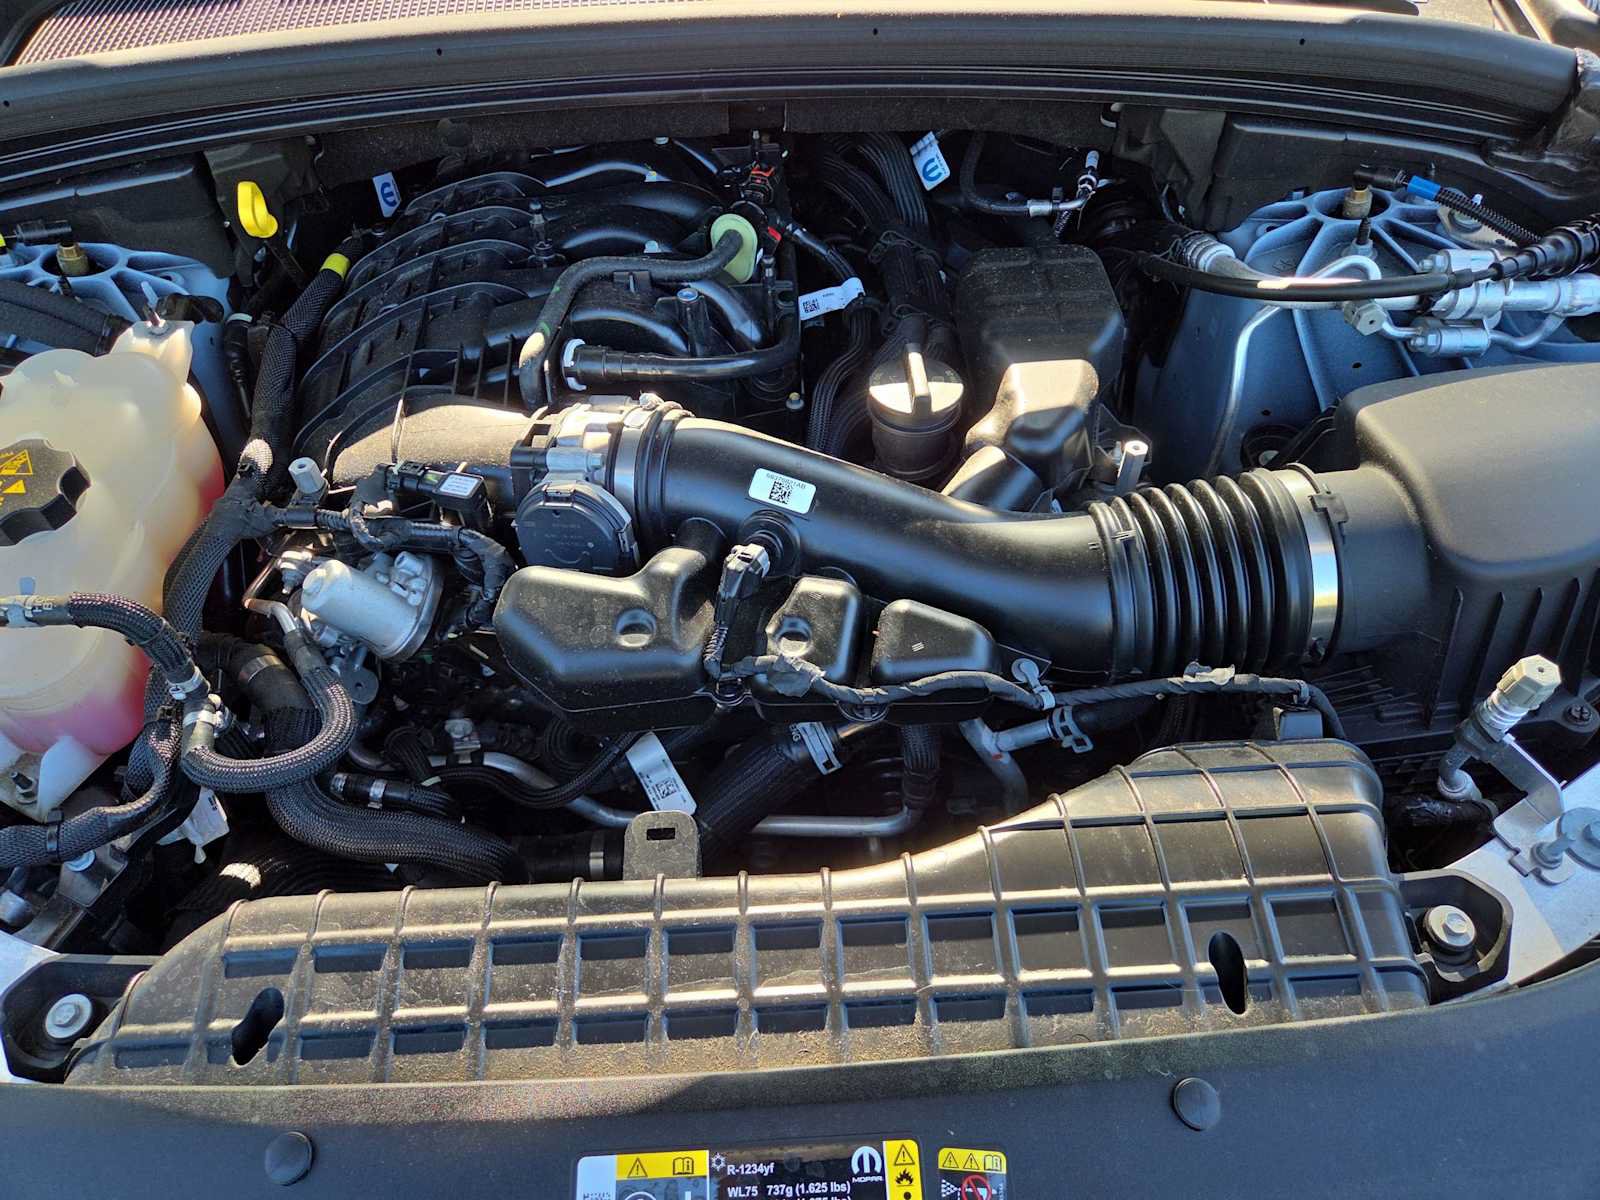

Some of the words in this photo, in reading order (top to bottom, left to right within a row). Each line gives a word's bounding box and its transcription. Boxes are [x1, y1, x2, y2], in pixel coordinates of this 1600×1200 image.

[727, 1163, 774, 1176] R-1234yf
[727, 1186, 758, 1198] WL75
[766, 1184, 793, 1196] 737g
[795, 1182, 828, 1195] (1.625
[830, 1181, 851, 1194] lbs)
